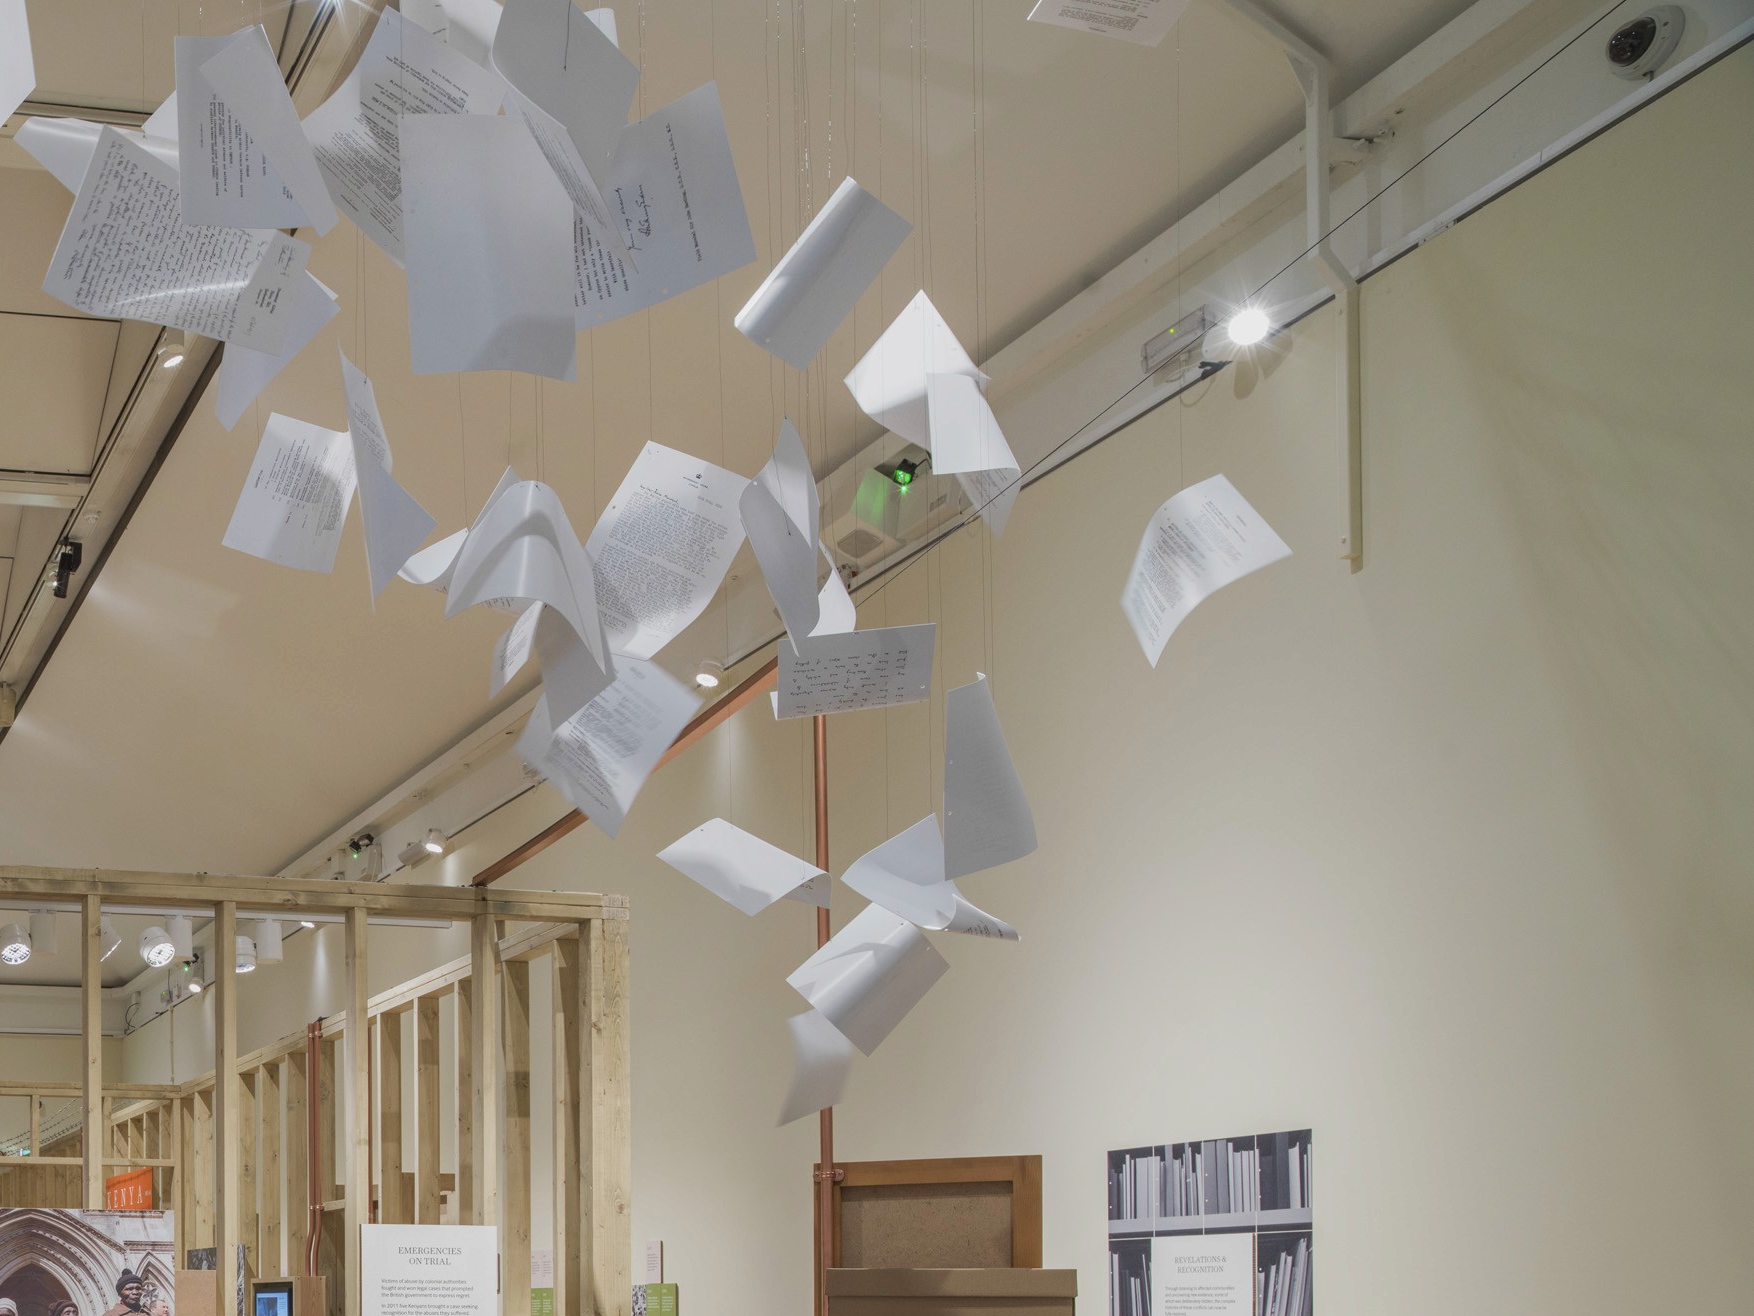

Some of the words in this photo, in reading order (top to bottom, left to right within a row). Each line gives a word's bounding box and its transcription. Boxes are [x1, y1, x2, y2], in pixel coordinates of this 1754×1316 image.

[107, 1185, 143, 1209] KENYA
[398, 1247, 461, 1255] EMERGENCIES
[424, 1258, 451, 1266] TRIAL
[1174, 1256, 1221, 1264] REVELATIONS
[1177, 1265, 1224, 1274] RECOGNITION
